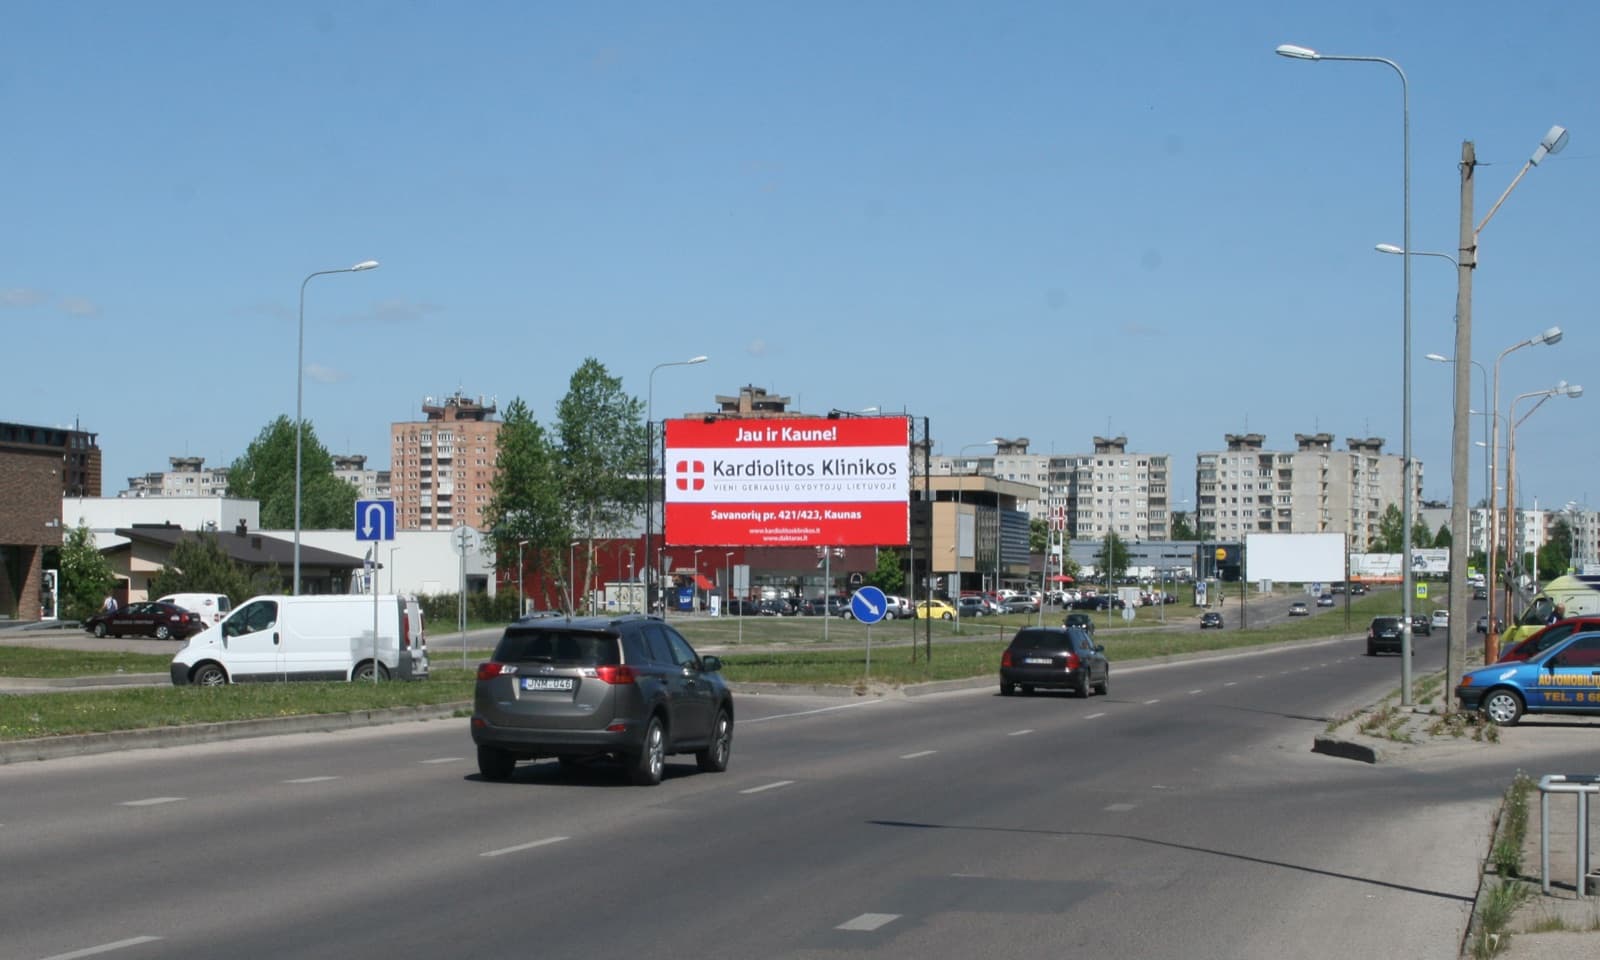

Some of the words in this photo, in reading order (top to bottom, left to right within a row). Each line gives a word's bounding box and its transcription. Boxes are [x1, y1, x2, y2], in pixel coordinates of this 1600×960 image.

[736, 427, 762, 442] Jau
[767, 427, 778, 442] ir
[782, 427, 837, 442] Kaune!
[713, 460, 814, 477] Kardiolitos
[822, 459, 897, 476] Klinikos
[847, 483, 897, 491] LIETUVOJE
[711, 510, 761, 522] Savanorių
[763, 512, 777, 522] pr.
[778, 510, 822, 521] 421/423,
[824, 510, 862, 520] Kaunas
[1544, 692, 1572, 702] TEL.
[1576, 692, 1584, 702] 8
